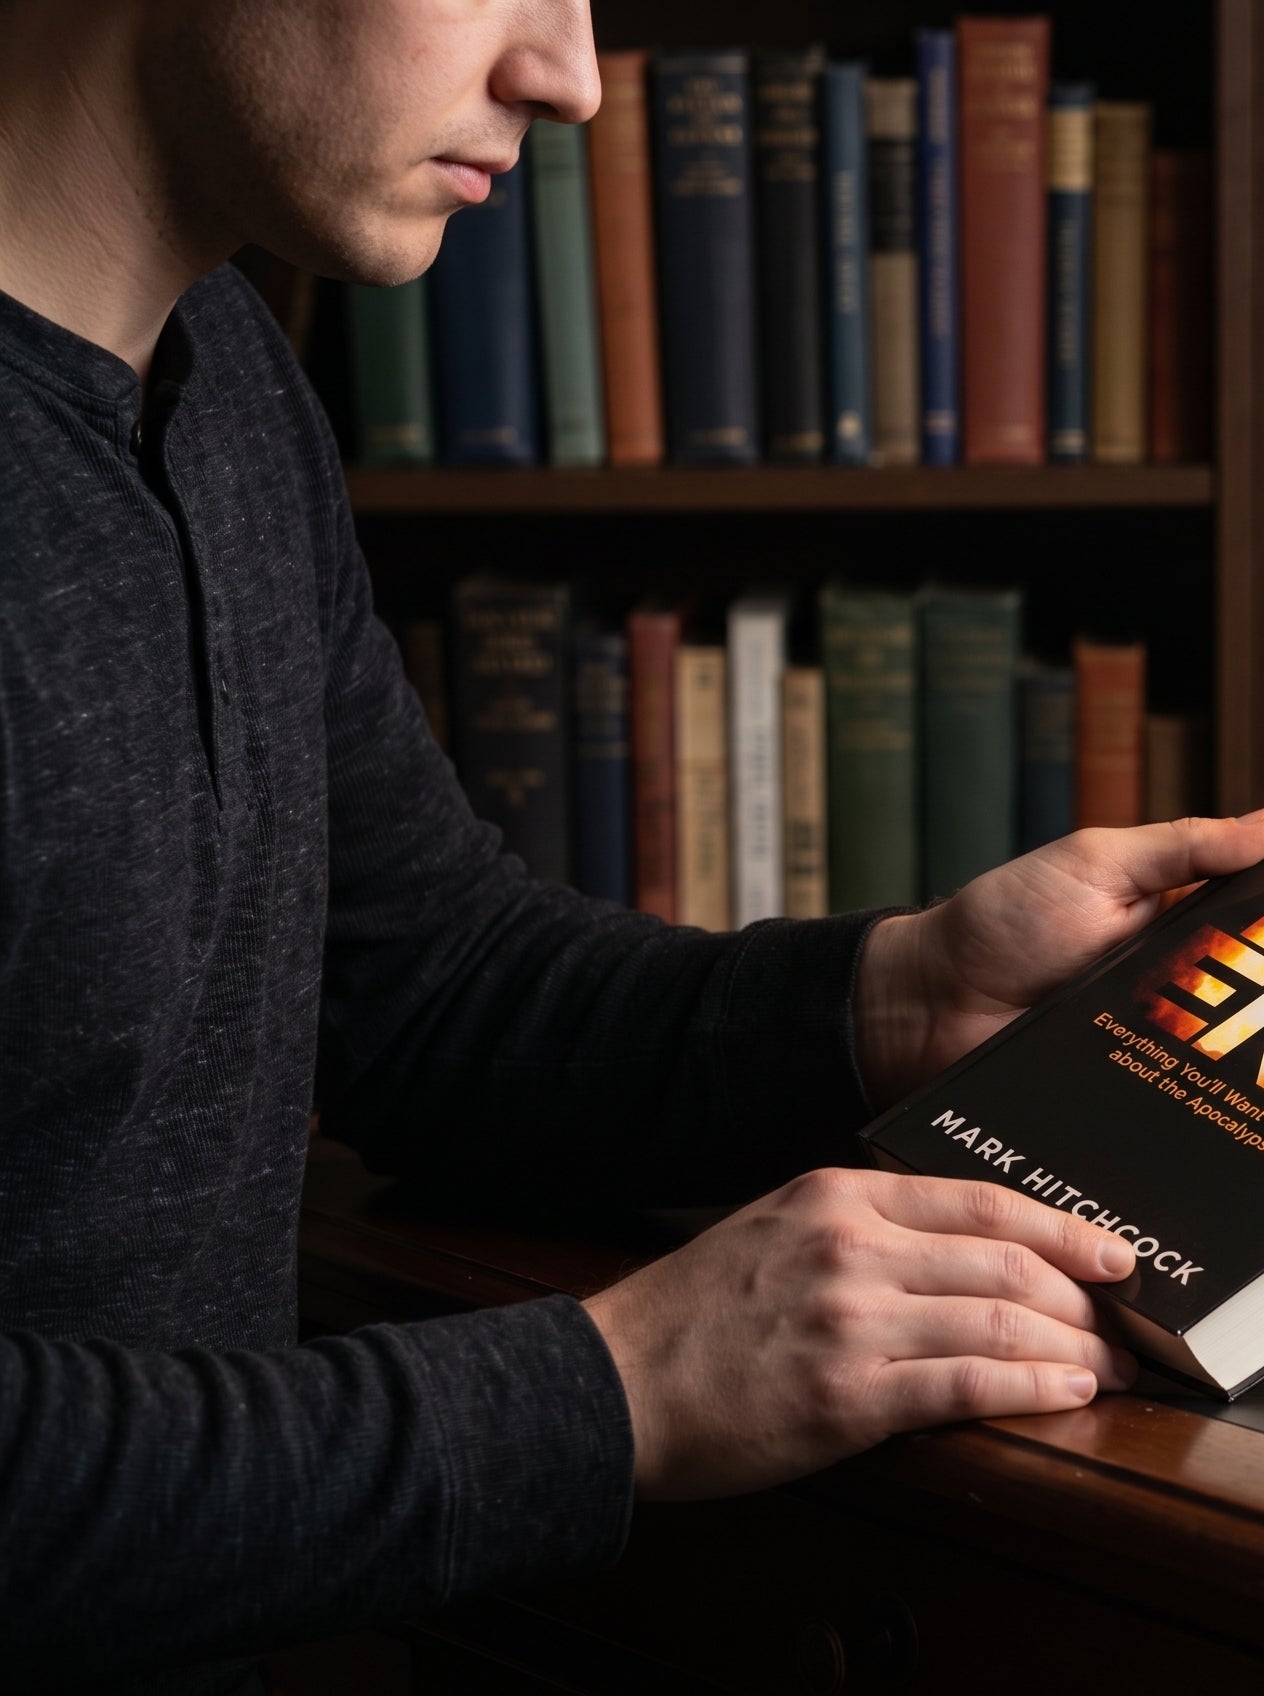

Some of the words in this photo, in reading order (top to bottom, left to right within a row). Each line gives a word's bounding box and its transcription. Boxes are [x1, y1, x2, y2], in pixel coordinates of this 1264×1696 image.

[1093, 1012, 1179, 1071] Everything
[1179, 1062, 1227, 1095] You'll
[1109, 1049, 1161, 1083] about
[1158, 1076, 1188, 1101] the
[931, 1109, 1026, 1174] MARK
[1021, 1167, 1205, 1286] HITCHCOCK
